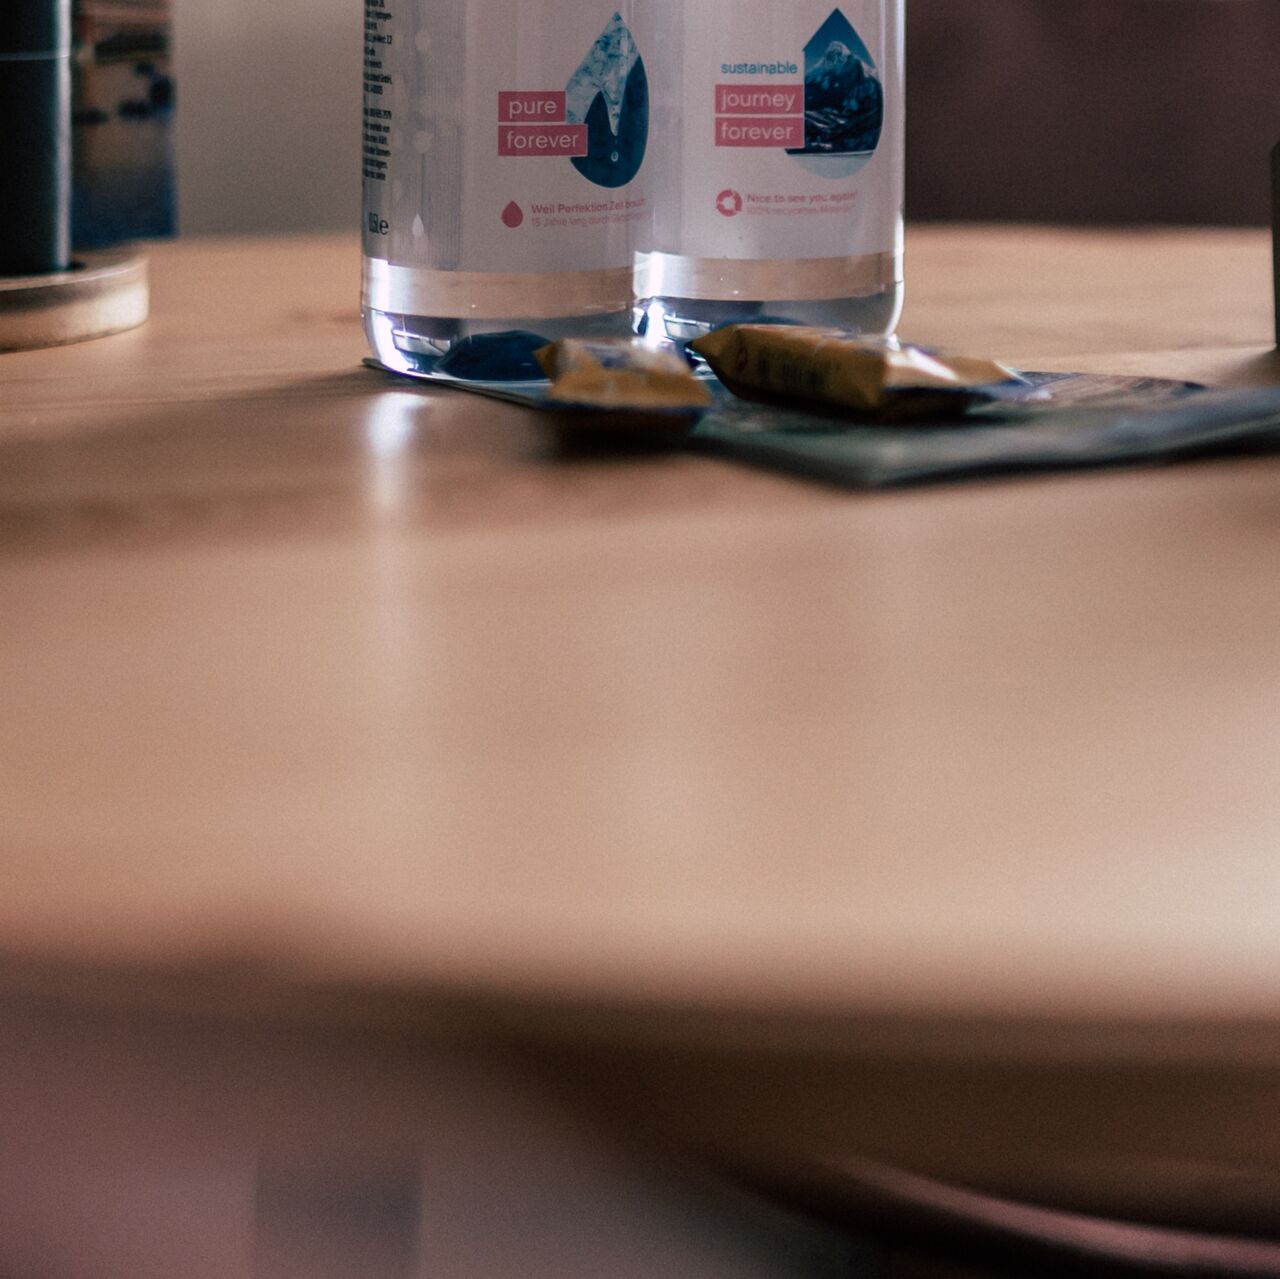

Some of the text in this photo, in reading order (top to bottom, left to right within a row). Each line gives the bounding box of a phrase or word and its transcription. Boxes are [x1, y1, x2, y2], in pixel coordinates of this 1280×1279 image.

[721, 60, 798, 75] sustainable
[509, 100, 557, 120] pure
[721, 89, 797, 112] journey
[506, 130, 580, 149] forever
[721, 122, 794, 141] forever
[531, 203, 555, 214] Weil
[746, 193, 770, 202] Nice
[774, 193, 785, 203] to
[809, 193, 827, 205] you
